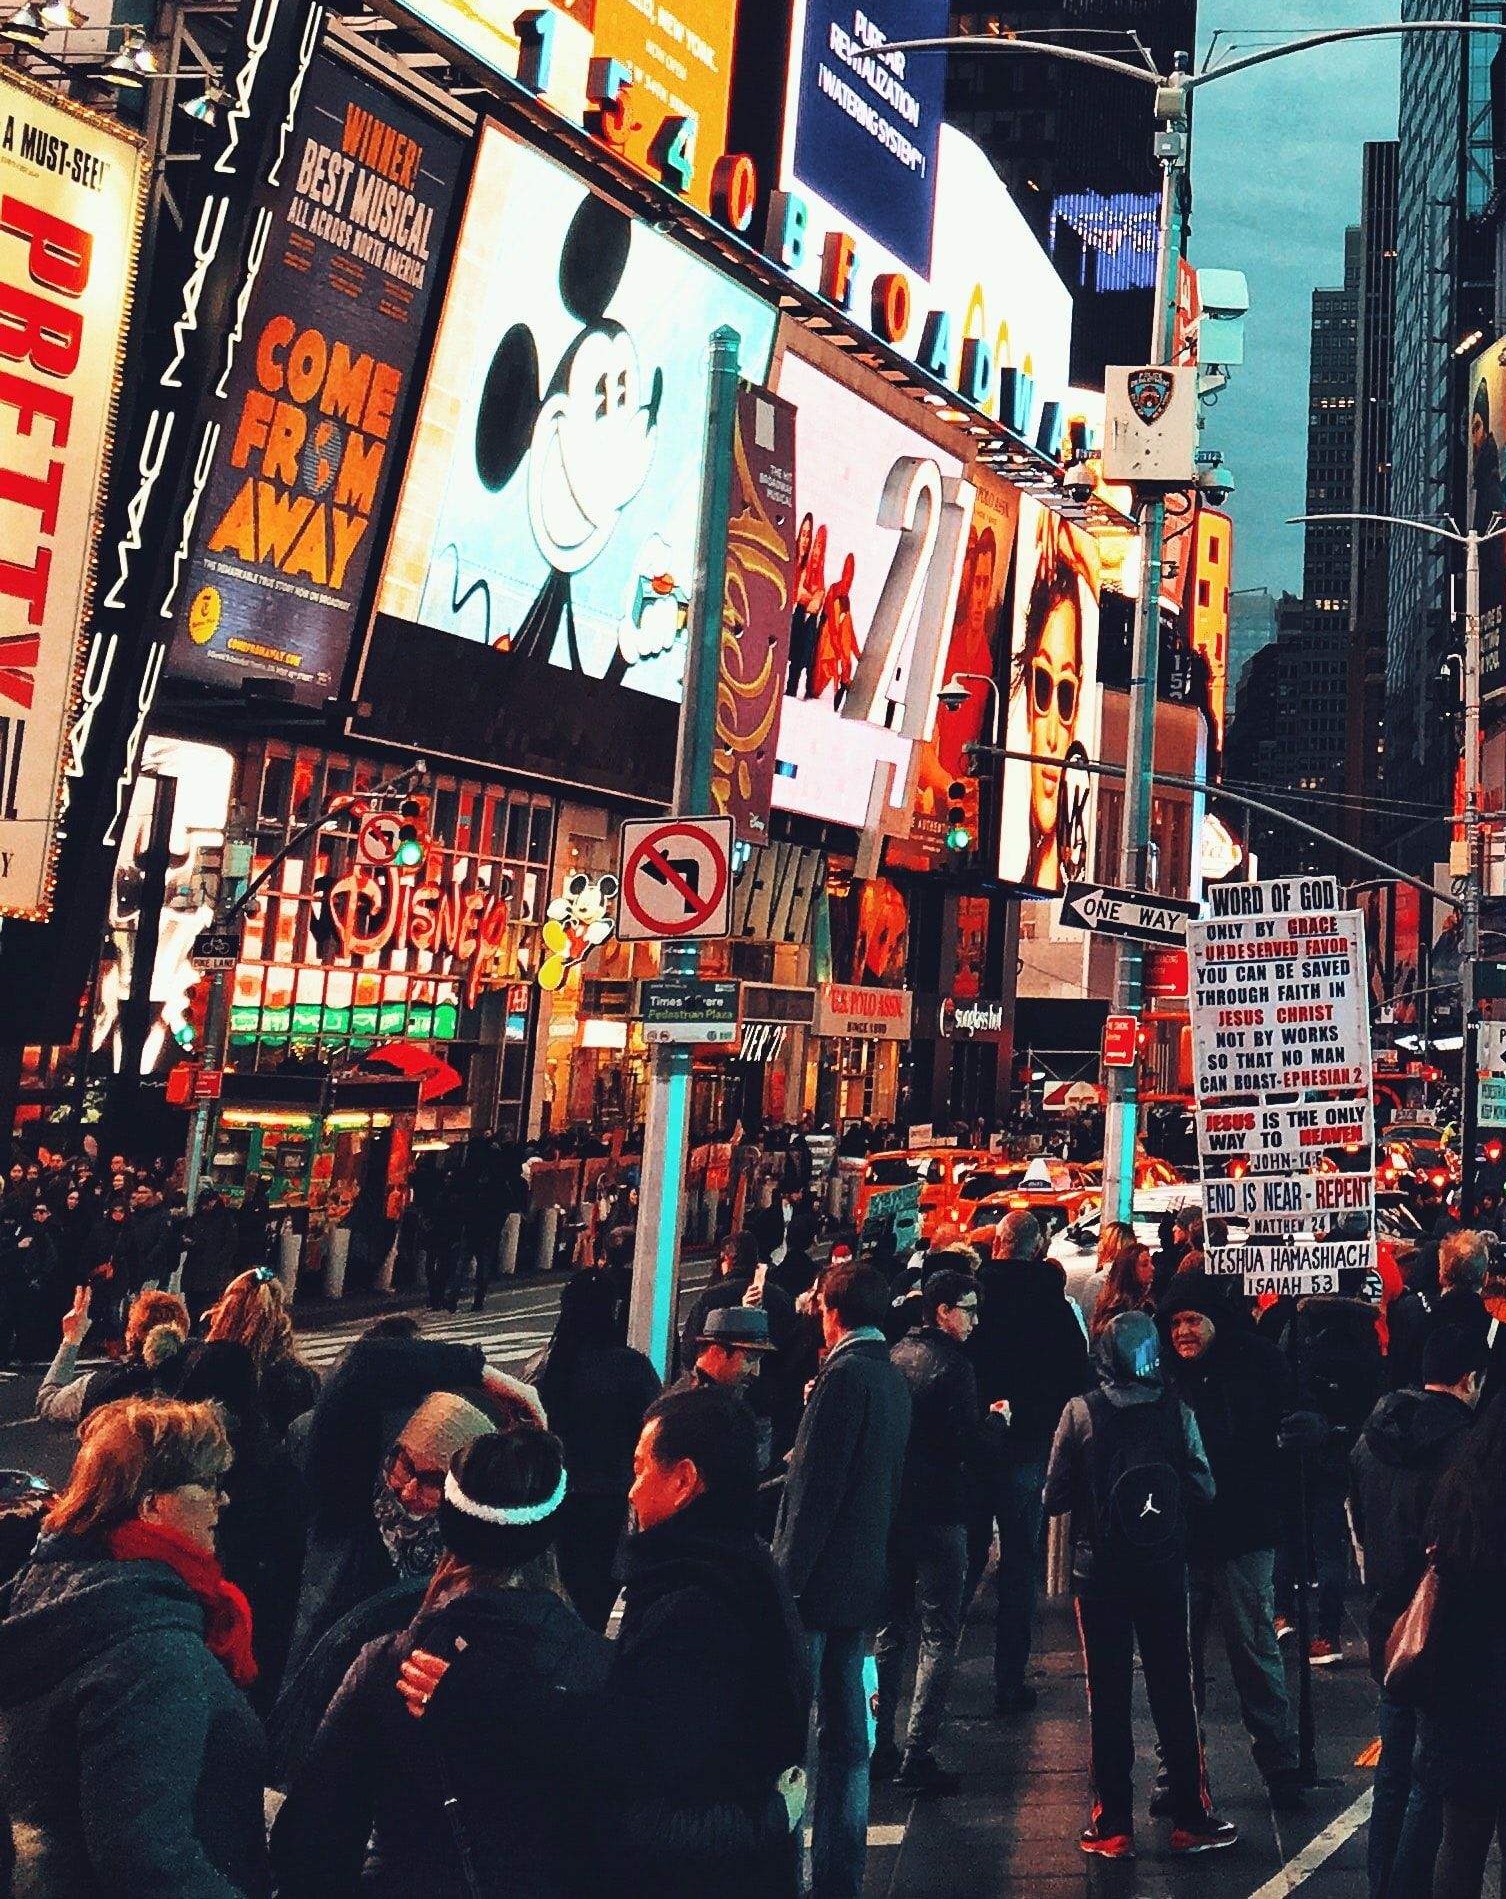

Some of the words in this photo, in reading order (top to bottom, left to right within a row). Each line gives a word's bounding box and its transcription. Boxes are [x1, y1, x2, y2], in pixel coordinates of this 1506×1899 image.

[2, 115, 14, 152] A
[342, 101, 424, 192] WINNER!
[296, 137, 356, 214] BEST
[349, 168, 434, 261] MUSICAL
[286, 196, 308, 230] ALL
[308, 207, 353, 251] ACROSS
[352, 229, 384, 271] NORTH
[382, 246, 427, 290] AMERICA
[257, 314, 403, 440] COME
[0, 194, 94, 711] PRETTY
[207, 476, 369, 590] AWAY
[1212, 886, 1263, 916] WORD
[1271, 884, 1291, 912] OF
[1300, 881, 1335, 910] GOD
[1083, 900, 1122, 921] ONE
[1138, 907, 1181, 931] WAY
[1206, 923, 1243, 940] ONLY
[1255, 921, 1275, 937] BY
[1287, 917, 1338, 935] GRACE
[1205, 940, 1298, 961] UNDESERVED
[1305, 937, 1348, 955] FAVOR
[1197, 967, 1228, 984] YOU
[1236, 965, 1267, 981] CAN
[1275, 963, 1294, 979] BE
[1302, 959, 1350, 978] SAVED
[651, 995, 682, 1007] Times
[1196, 986, 1270, 1006] THROUGH
[1277, 983, 1321, 1002] FAITH
[1329, 981, 1346, 998] IN
[650, 1009, 703, 1021] Pedestrian
[706, 1011, 733, 1021] Plaza
[1218, 1009, 1264, 1027] JESUS
[1276, 1005, 1333, 1024] CHRIST
[1216, 1031, 1246, 1048] NOT
[1254, 1030, 1273, 1046] BY
[1282, 1026, 1339, 1045] WORKS
[1207, 1054, 1228, 1070] SO
[1236, 1052, 1274, 1069] THAT
[1282, 1052, 1303, 1066] NO
[1311, 1047, 1345, 1064] MAN
[1199, 1076, 1227, 1093] CAN
[1353, 1066, 1363, 1083] 2
[1206, 1112, 1256, 1133] JESUS
[1263, 1112, 1280, 1129] IS
[1287, 1109, 1318, 1128] THE
[1325, 1106, 1366, 1124] ONLY
[1209, 1132, 1246, 1151] WAY
[1260, 1131, 1282, 1148] TO
[1299, 1125, 1363, 1147] HEAVEN
[1206, 1183, 1236, 1214] END
[1243, 1182, 1257, 1212] IS
[1263, 1181, 1300, 1212] NEAR
[1315, 1177, 1372, 1209] REPENT
[1310, 1216, 1326, 1232] 24
[1208, 1247, 1264, 1273] YESHUA
[1270, 1243, 1370, 1270] HAMASHIACH
[1248, 1275, 1300, 1293] ISAIAH
[1311, 1274, 1333, 1292] 53
